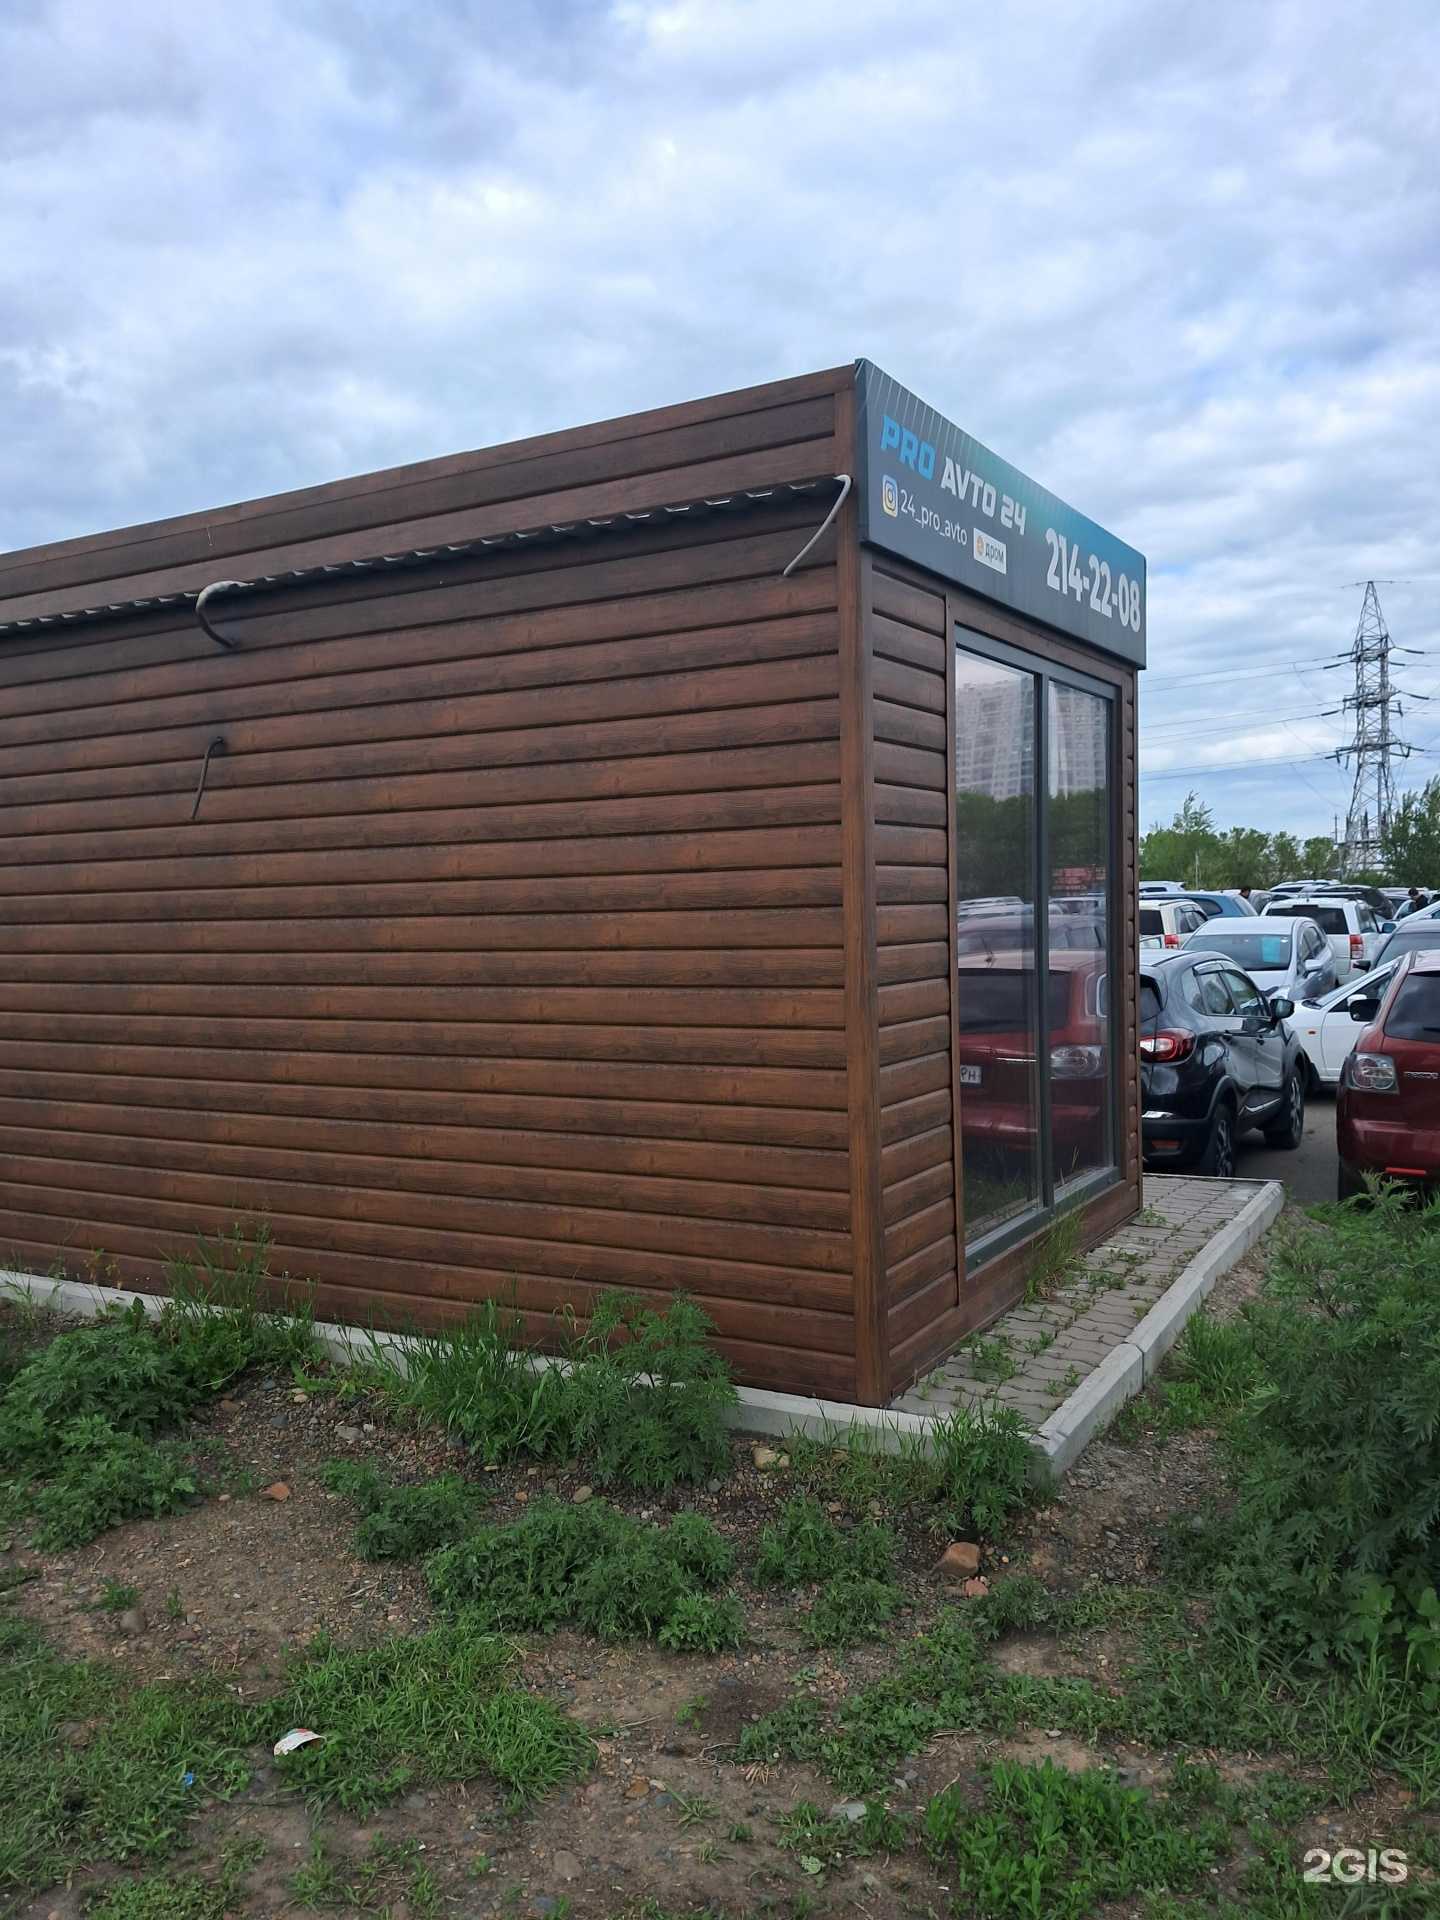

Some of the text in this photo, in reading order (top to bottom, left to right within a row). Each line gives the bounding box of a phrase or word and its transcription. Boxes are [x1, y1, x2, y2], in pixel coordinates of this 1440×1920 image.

[881, 415, 1026, 536] PRO AVTO 24
[900, 488, 968, 546] 24_pro_avto
[1045, 528, 1141, 633] 214-22-08
